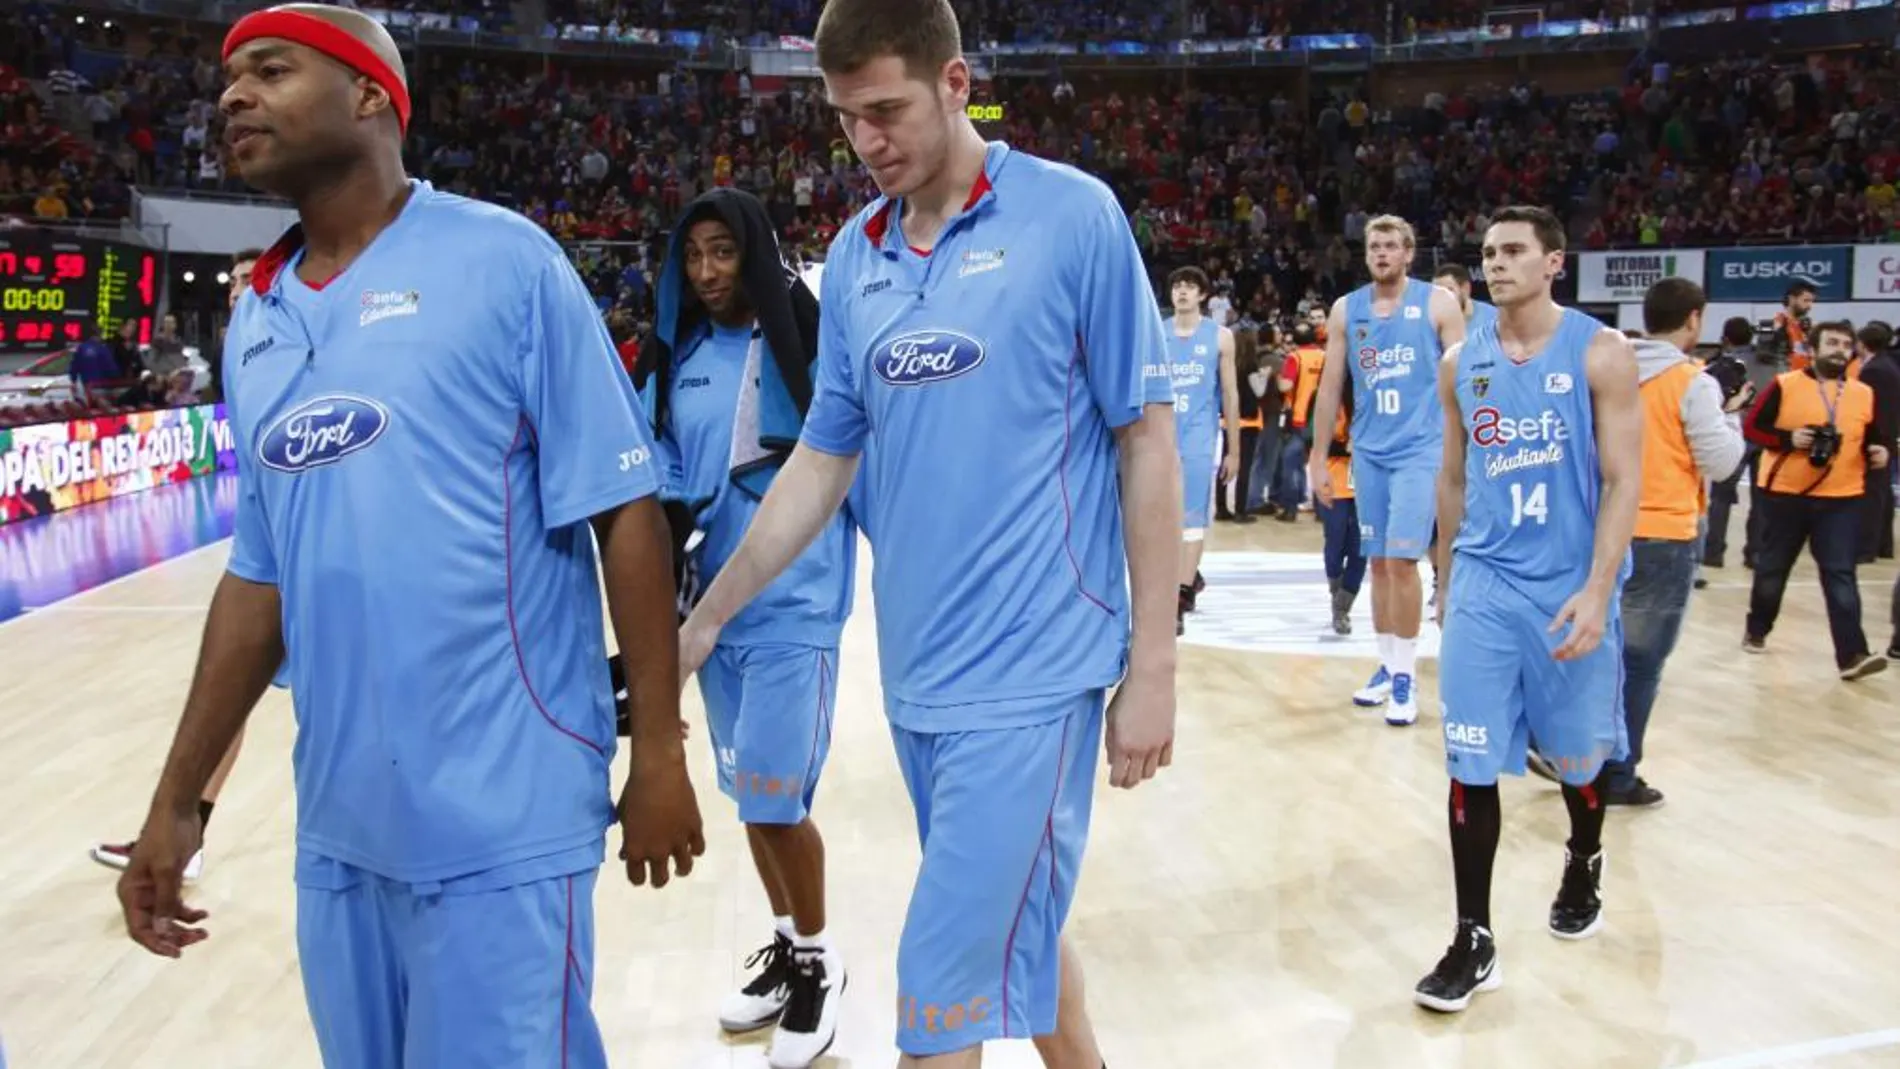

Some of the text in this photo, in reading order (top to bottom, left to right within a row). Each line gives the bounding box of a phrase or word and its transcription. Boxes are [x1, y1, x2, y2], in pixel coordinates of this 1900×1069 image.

[1605, 255, 1662, 271] VITORIA
[1723, 260, 1833, 279] EUSKADI
[4, 288, 65, 311] 00:00
[886, 335, 959, 379] Ford
[1376, 388, 1400, 415] 10
[285, 405, 356, 464] Ford
[52, 440, 97, 488] DEL
[101, 432, 141, 478] REY
[147, 424, 196, 466] 2013
[1510, 482, 1549, 526] 14
[1446, 722, 1488, 745] GAES
